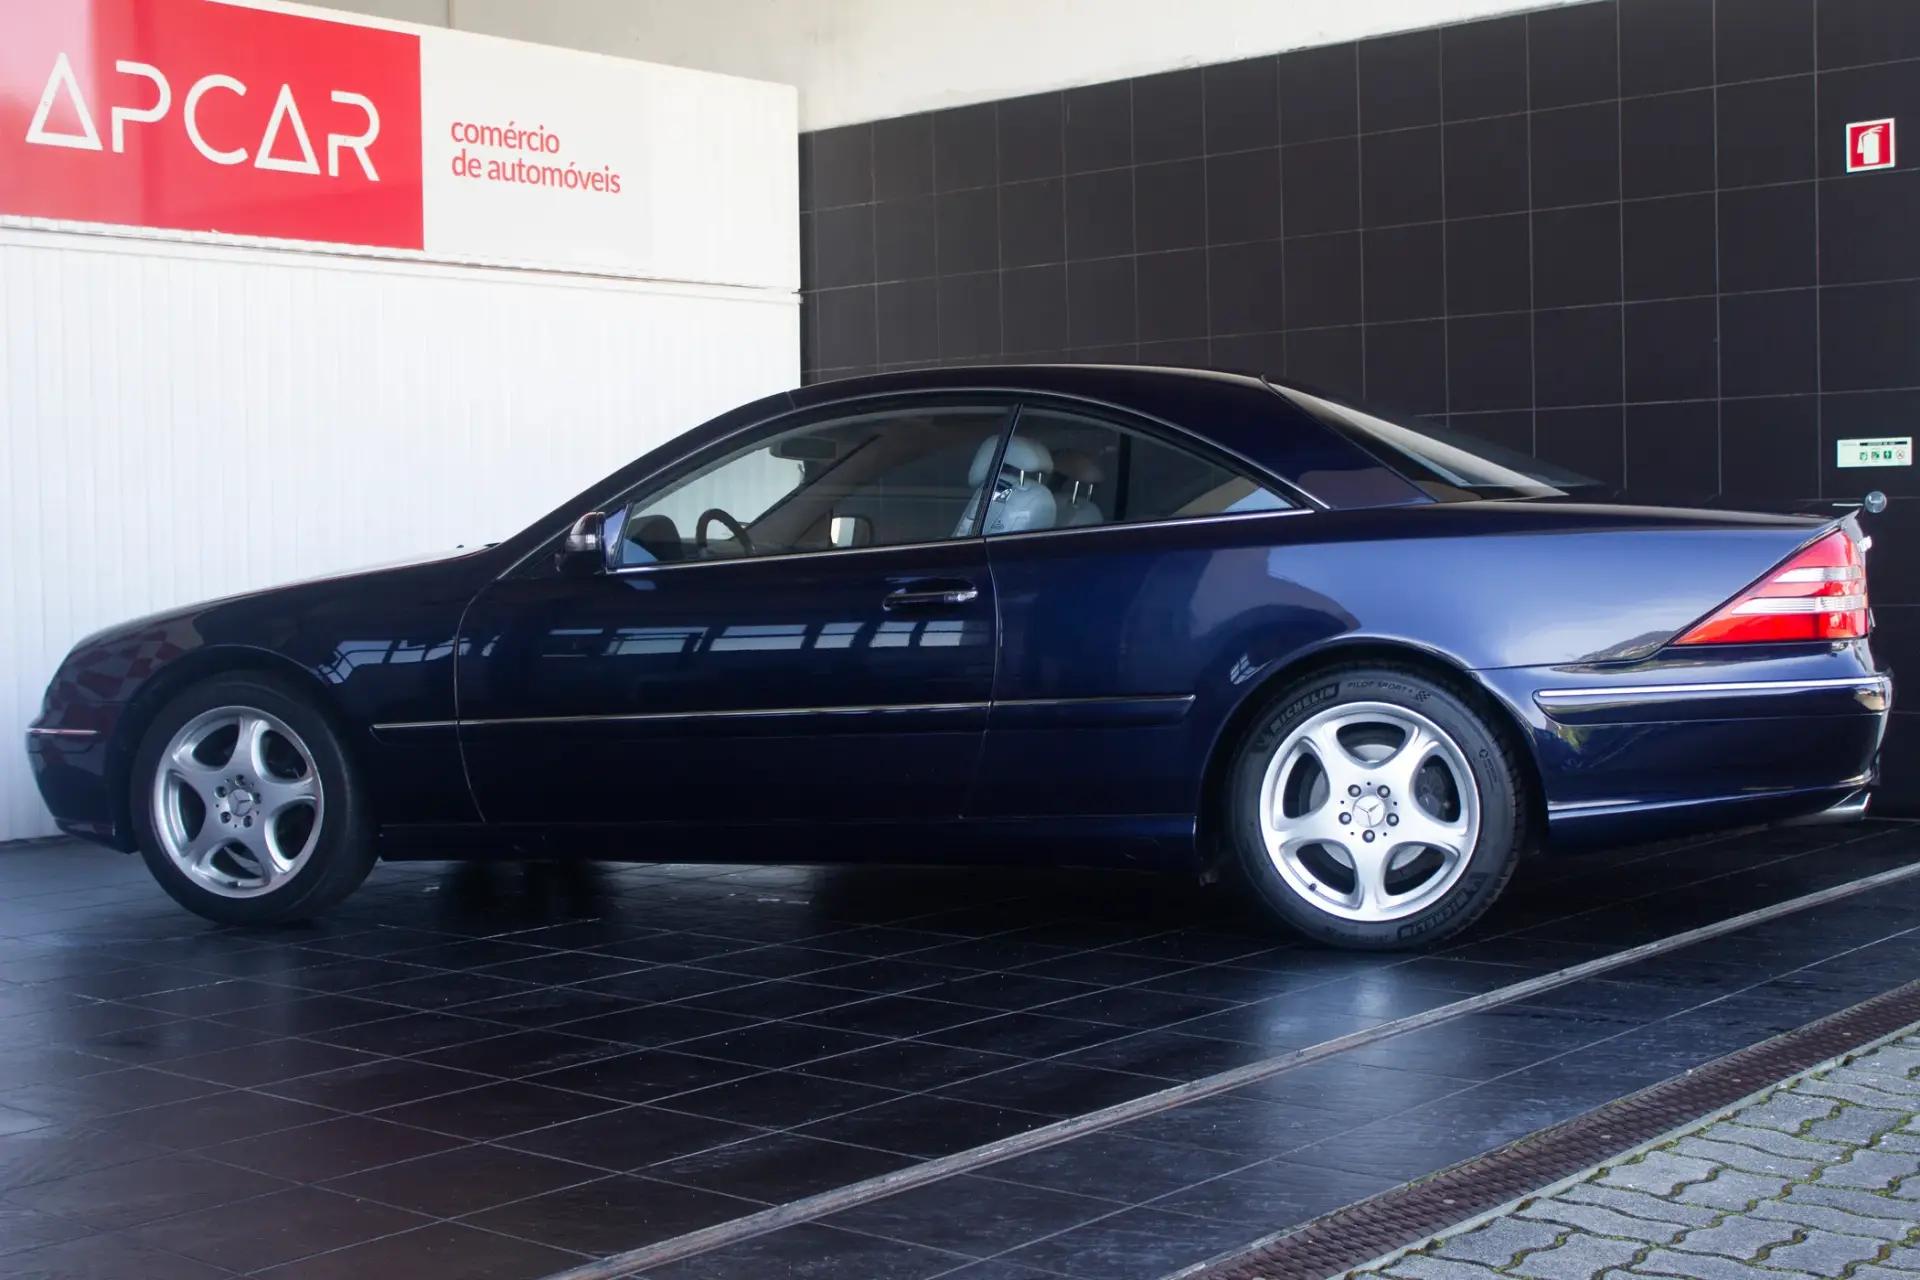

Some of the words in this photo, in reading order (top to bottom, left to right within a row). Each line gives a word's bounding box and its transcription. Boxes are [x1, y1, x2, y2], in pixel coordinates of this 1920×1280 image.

[25, 52, 380, 182] APCAR
[450, 120, 561, 154] comércio
[450, 149, 482, 179] de
[487, 159, 622, 194] automóveis
[1270, 684, 1337, 732] MICHELIN
